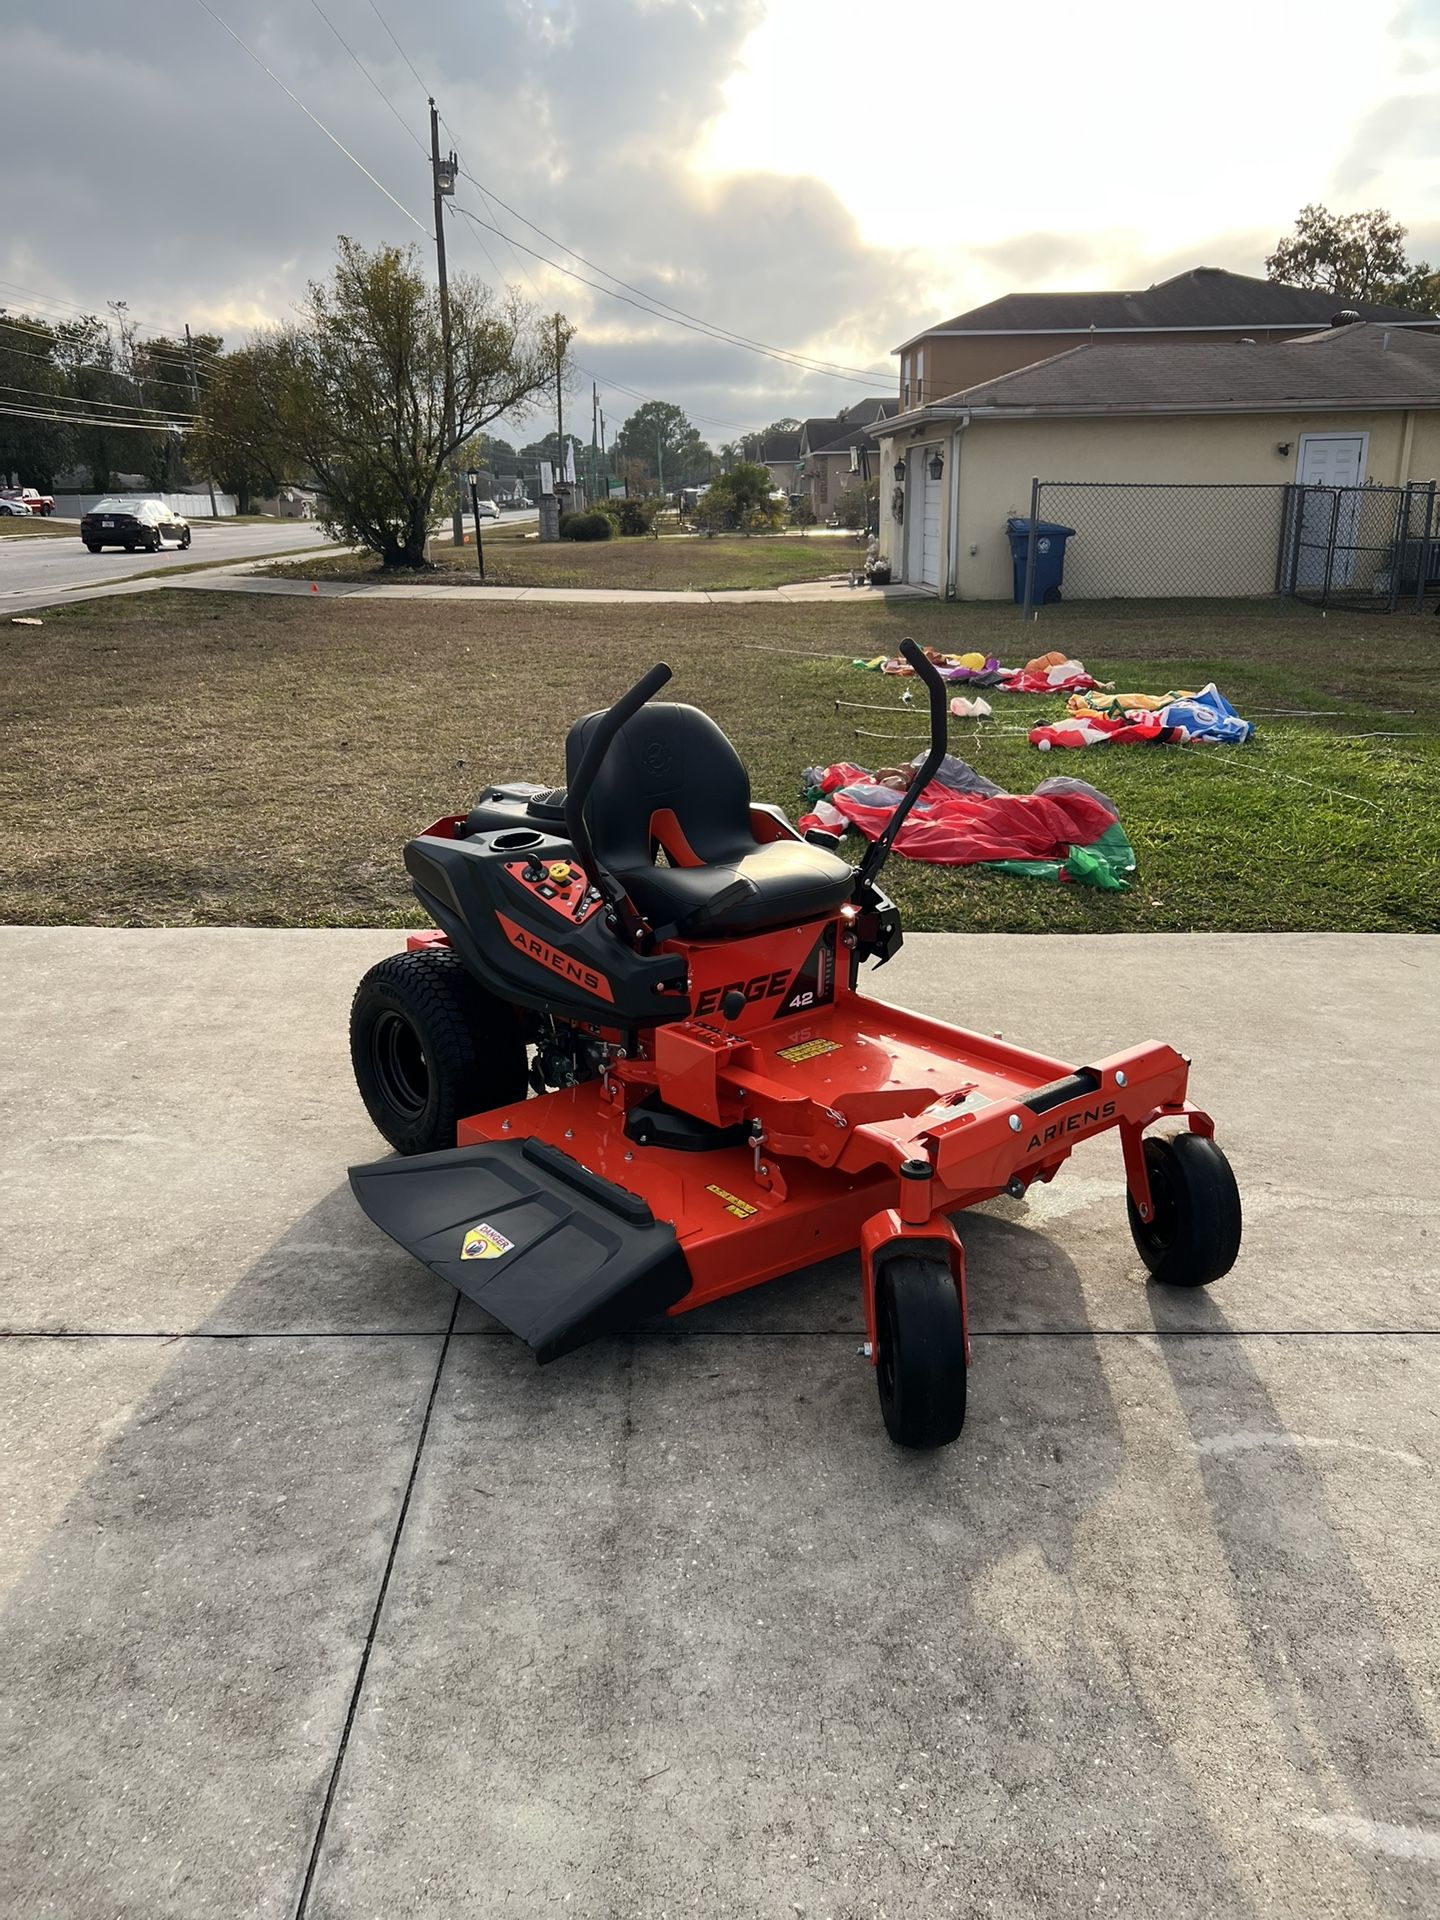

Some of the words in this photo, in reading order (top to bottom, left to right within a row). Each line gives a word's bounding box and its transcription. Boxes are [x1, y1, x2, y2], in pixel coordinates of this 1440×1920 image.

[514, 933, 599, 989] ARIENS
[789, 992, 814, 1008] 42
[1026, 1101, 1116, 1152] ARIENS
[480, 1226, 509, 1249] DANGER
